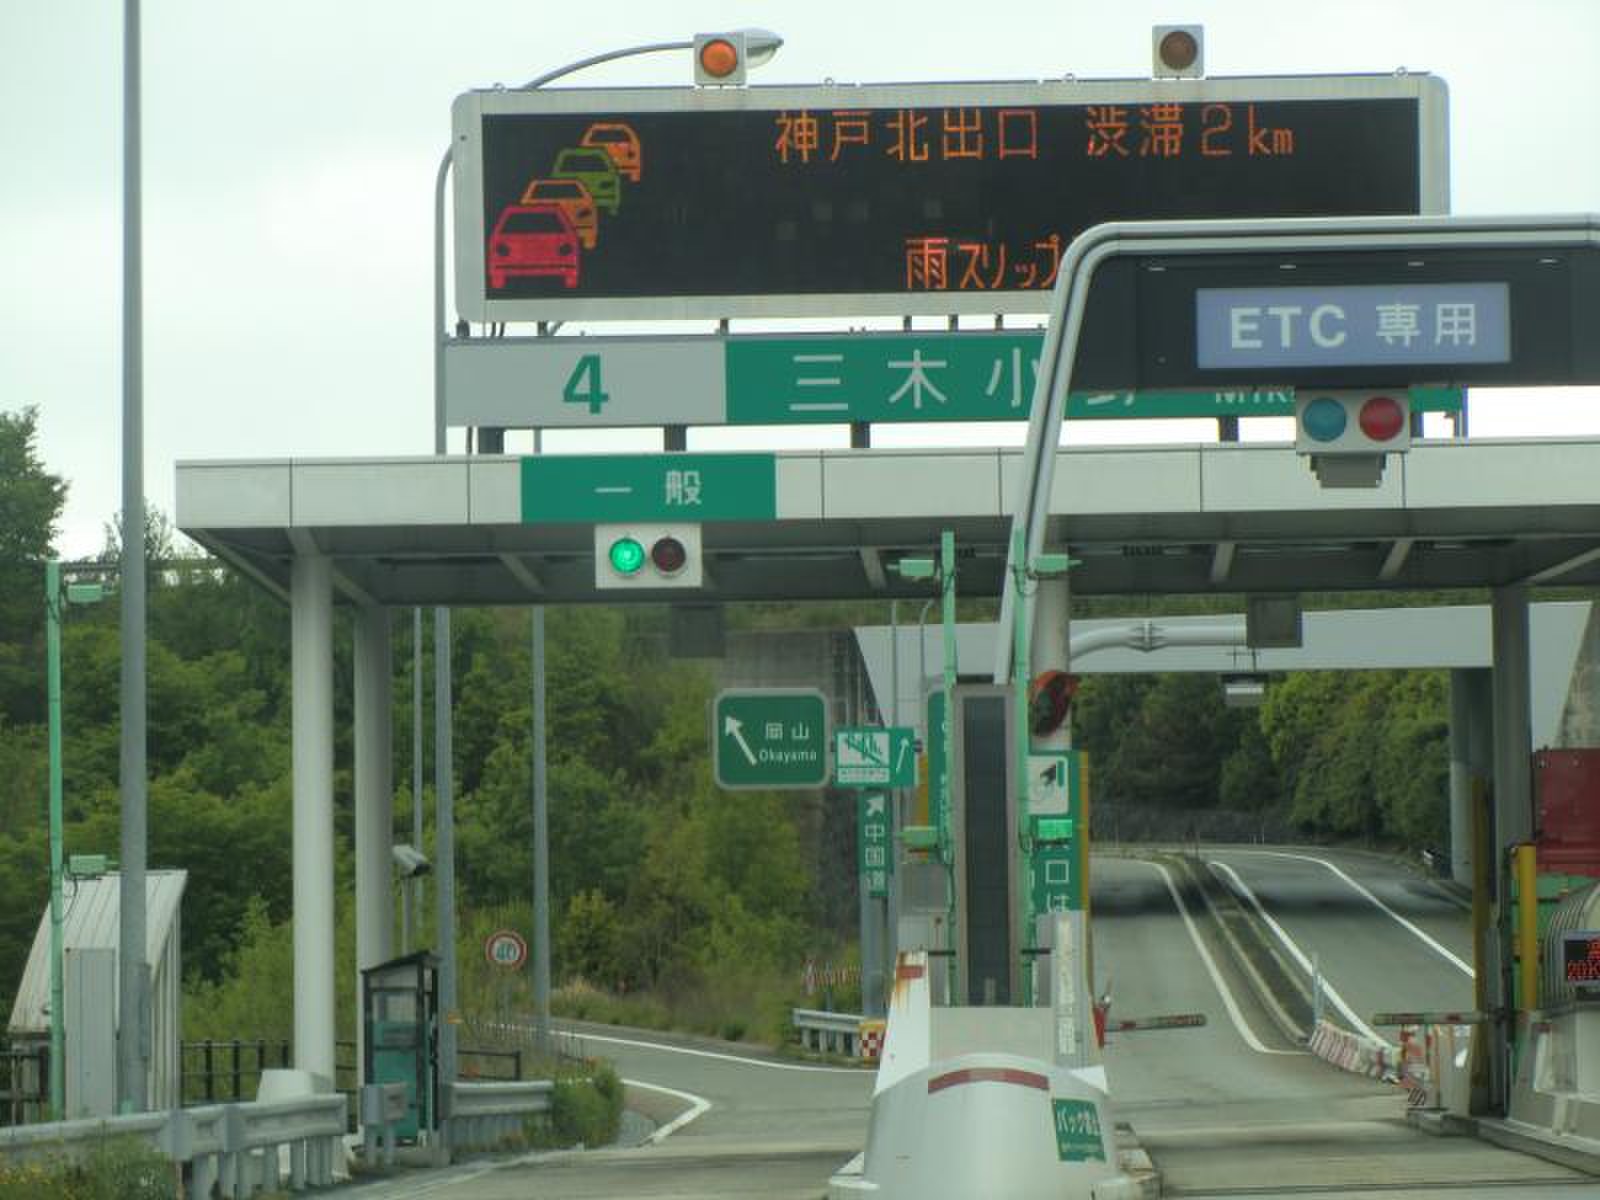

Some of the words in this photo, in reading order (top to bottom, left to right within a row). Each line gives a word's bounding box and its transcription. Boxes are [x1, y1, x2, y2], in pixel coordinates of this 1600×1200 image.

[774, 108, 1039, 164] 神戸北出口
[1230, 305, 1347, 349] ETC
[1375, 303, 1476, 347] 専用
[562, 353, 610, 414] 4
[594, 469, 703, 506] 一般
[765, 721, 810, 740] 岡山
[758, 747, 817, 764] Okayama
